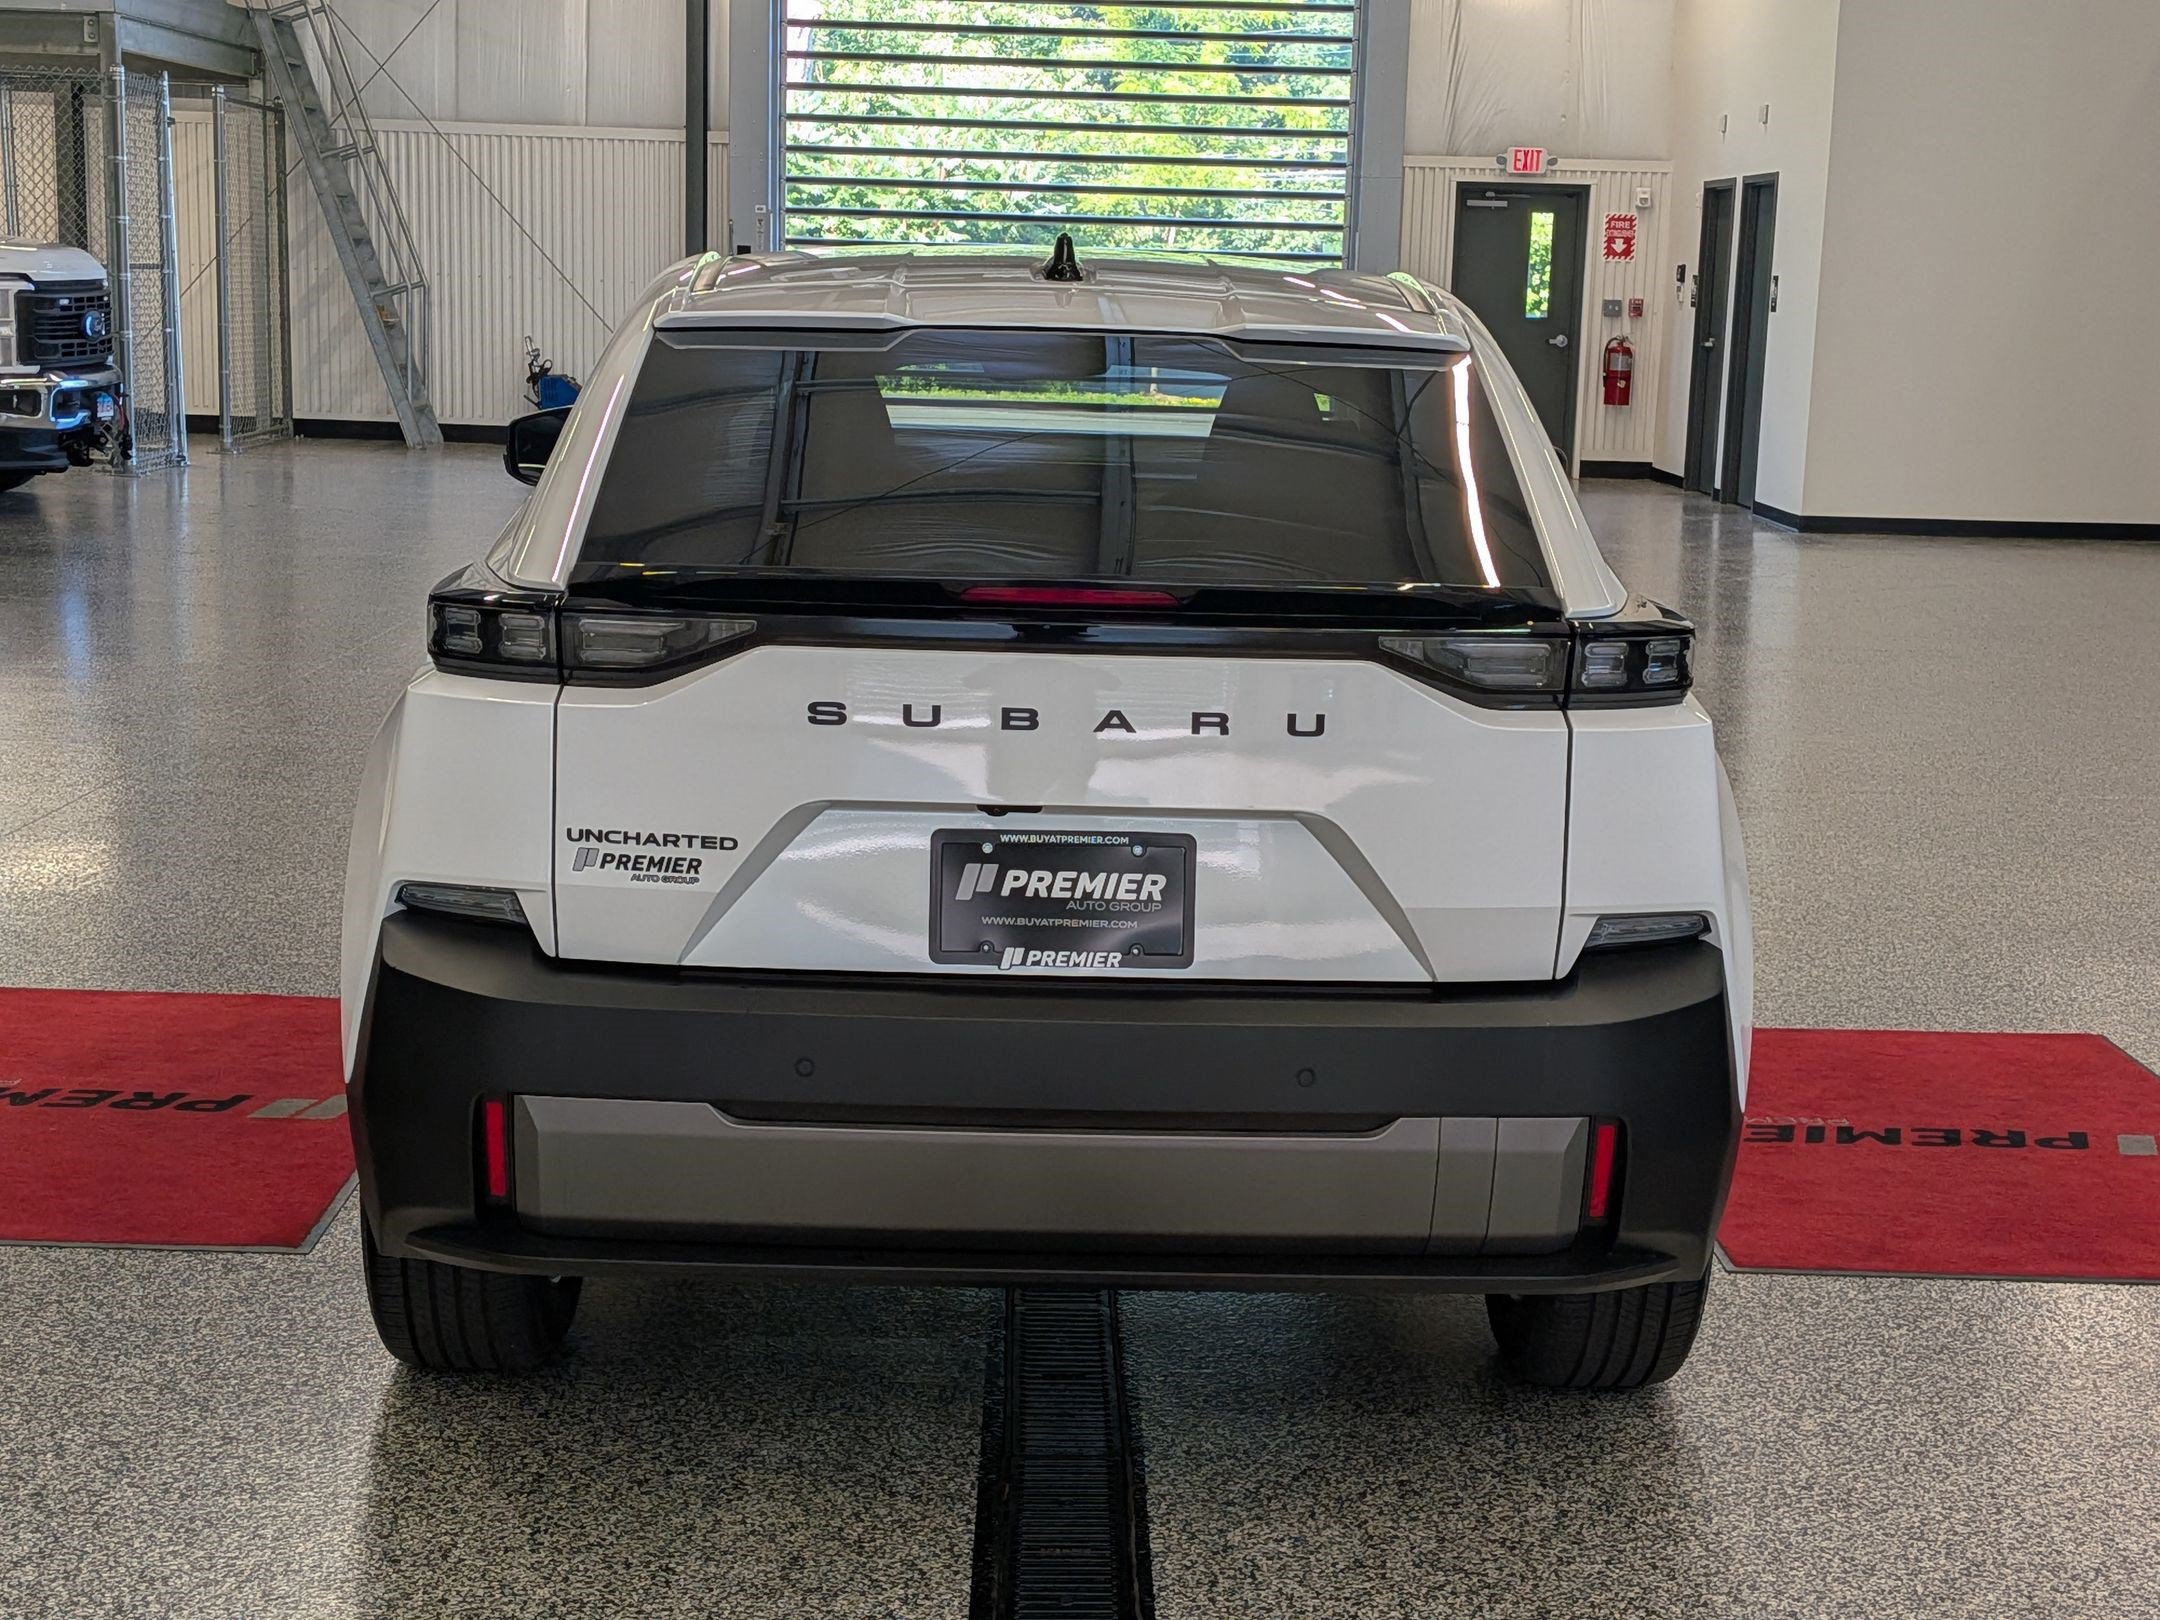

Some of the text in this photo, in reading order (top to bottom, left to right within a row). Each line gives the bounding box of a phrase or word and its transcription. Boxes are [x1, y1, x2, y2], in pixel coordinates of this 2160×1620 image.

[1513, 149, 1543, 171] EXIT
[1610, 220, 1631, 229] FIRE
[806, 701, 1326, 738] SUBARU
[566, 827, 739, 851] UNCHARTED
[1000, 833, 1129, 845] WWW.BUYATPREMIER.COM
[599, 852, 703, 875] PREMIER
[630, 873, 660, 883] AUTO
[1000, 869, 1167, 901] PREMIER
[1066, 900, 1162, 913] AUTO GROUP
[981, 916, 1138, 929] WWW.BUYATPREMIER.COM
[1026, 949, 1123, 969] PREMIER
